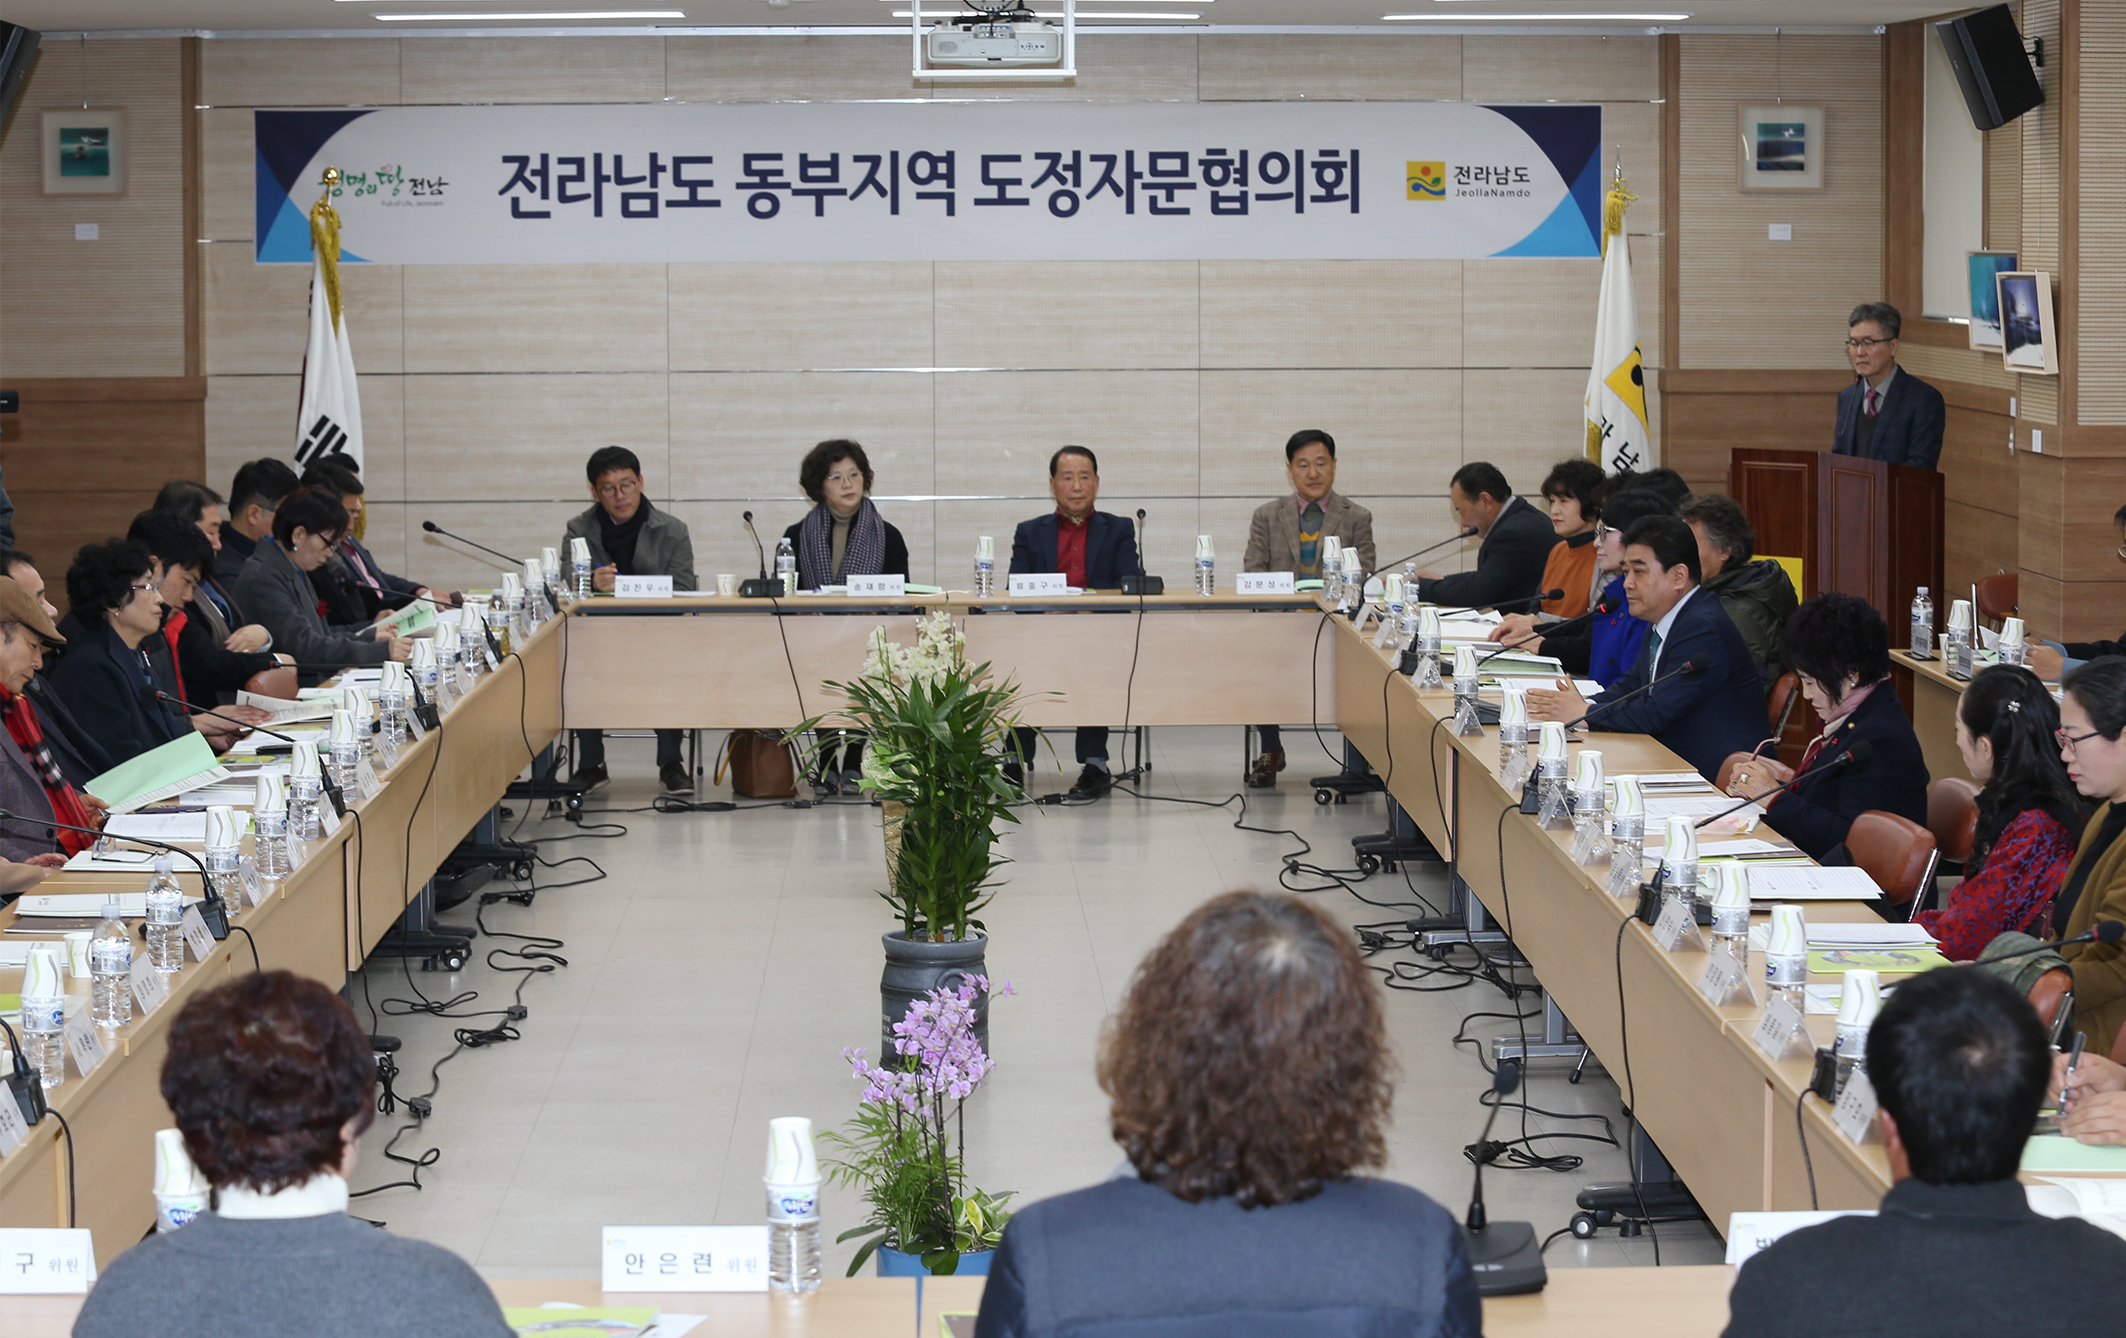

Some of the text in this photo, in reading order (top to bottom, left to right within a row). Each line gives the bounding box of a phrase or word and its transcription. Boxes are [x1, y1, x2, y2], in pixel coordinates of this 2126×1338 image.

[497, 148, 1360, 220] 전라남도 동부지역 도정자문협의회
[1453, 165, 1531, 186] 전라남도
[408, 176, 449, 196] 전남
[1455, 188, 1531, 198] JeollaNamdo
[48, 1257, 79, 1274] 위원
[728, 1257, 758, 1274] 위원
